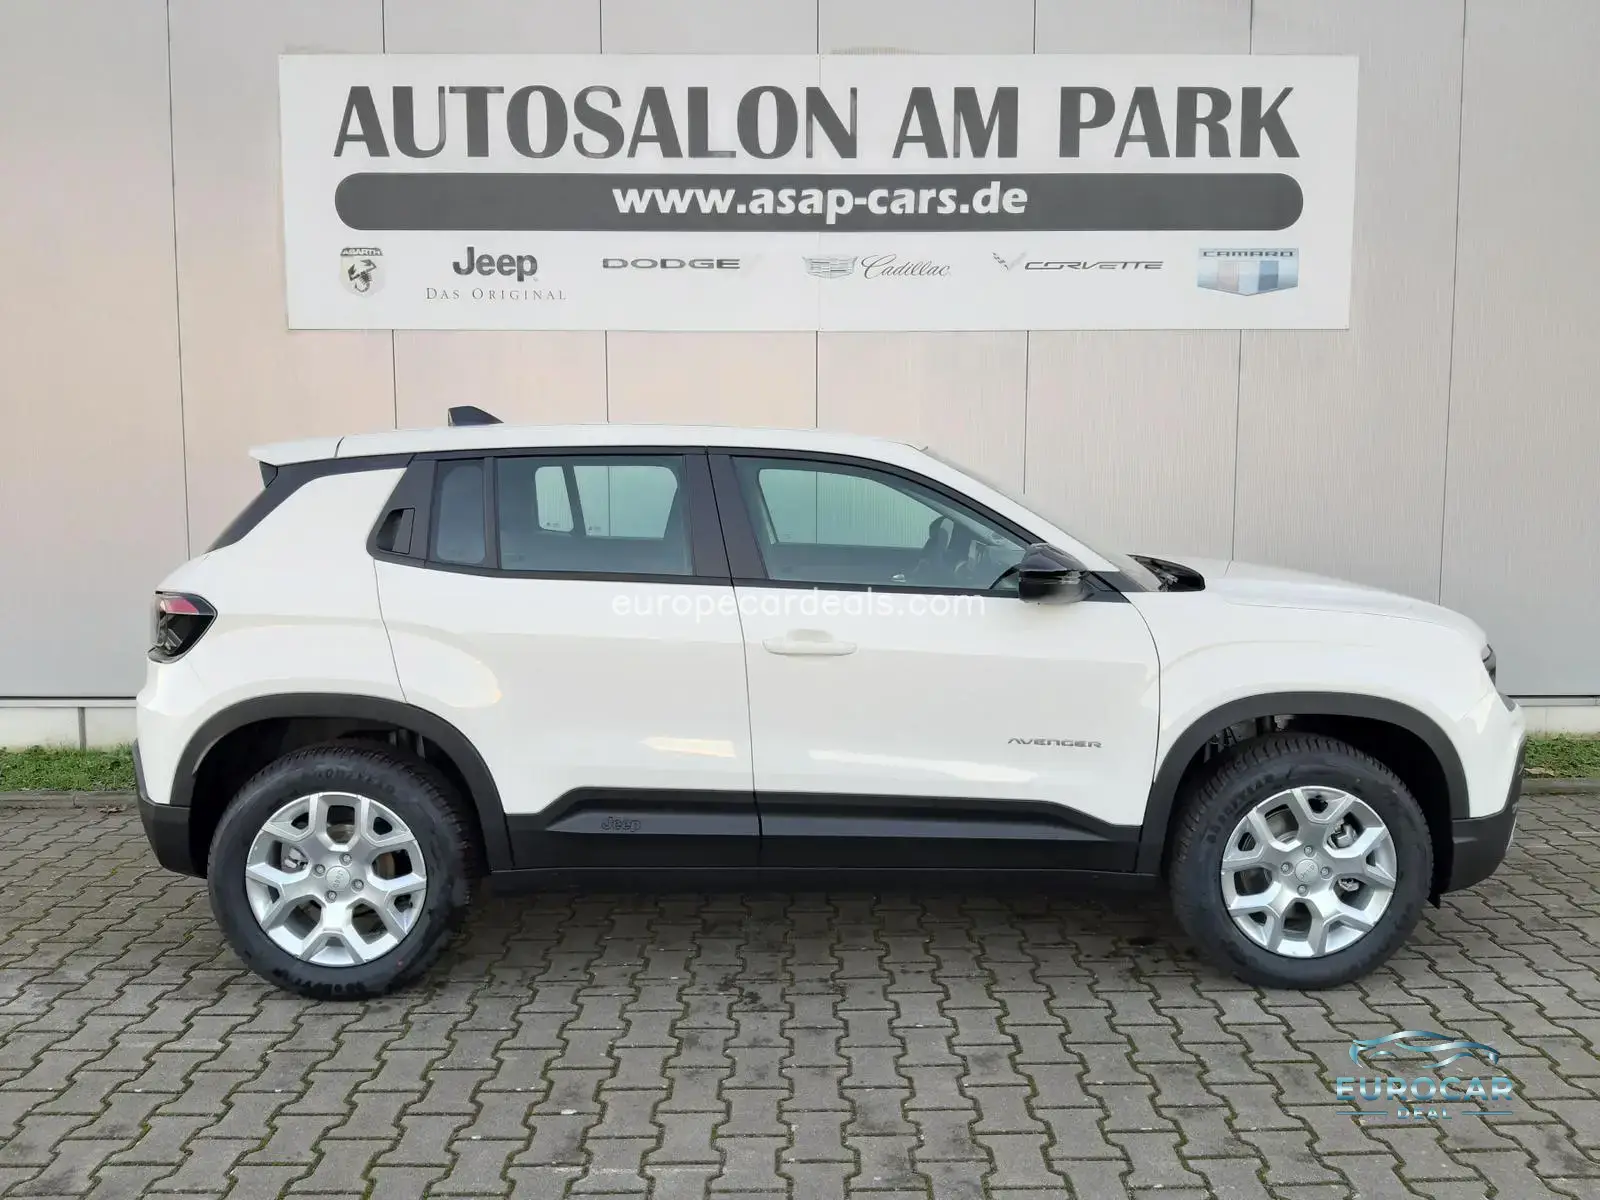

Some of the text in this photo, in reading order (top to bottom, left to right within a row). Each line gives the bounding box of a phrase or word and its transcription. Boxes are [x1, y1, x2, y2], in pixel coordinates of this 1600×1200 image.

[333, 85, 1301, 160] AUTOSALON AM PARK
[612, 181, 1028, 225] www.asap-cars.de
[1202, 250, 1294, 258] CAMARO
[452, 246, 538, 282] Jeep
[602, 258, 741, 270] DODGE
[860, 253, 952, 279] Cadillac
[1024, 260, 1164, 271] CORVETTE
[426, 287, 568, 301] DAS ORIGINAL
[1007, 737, 1102, 749] AVENGER
[600, 815, 643, 833] Jeep
